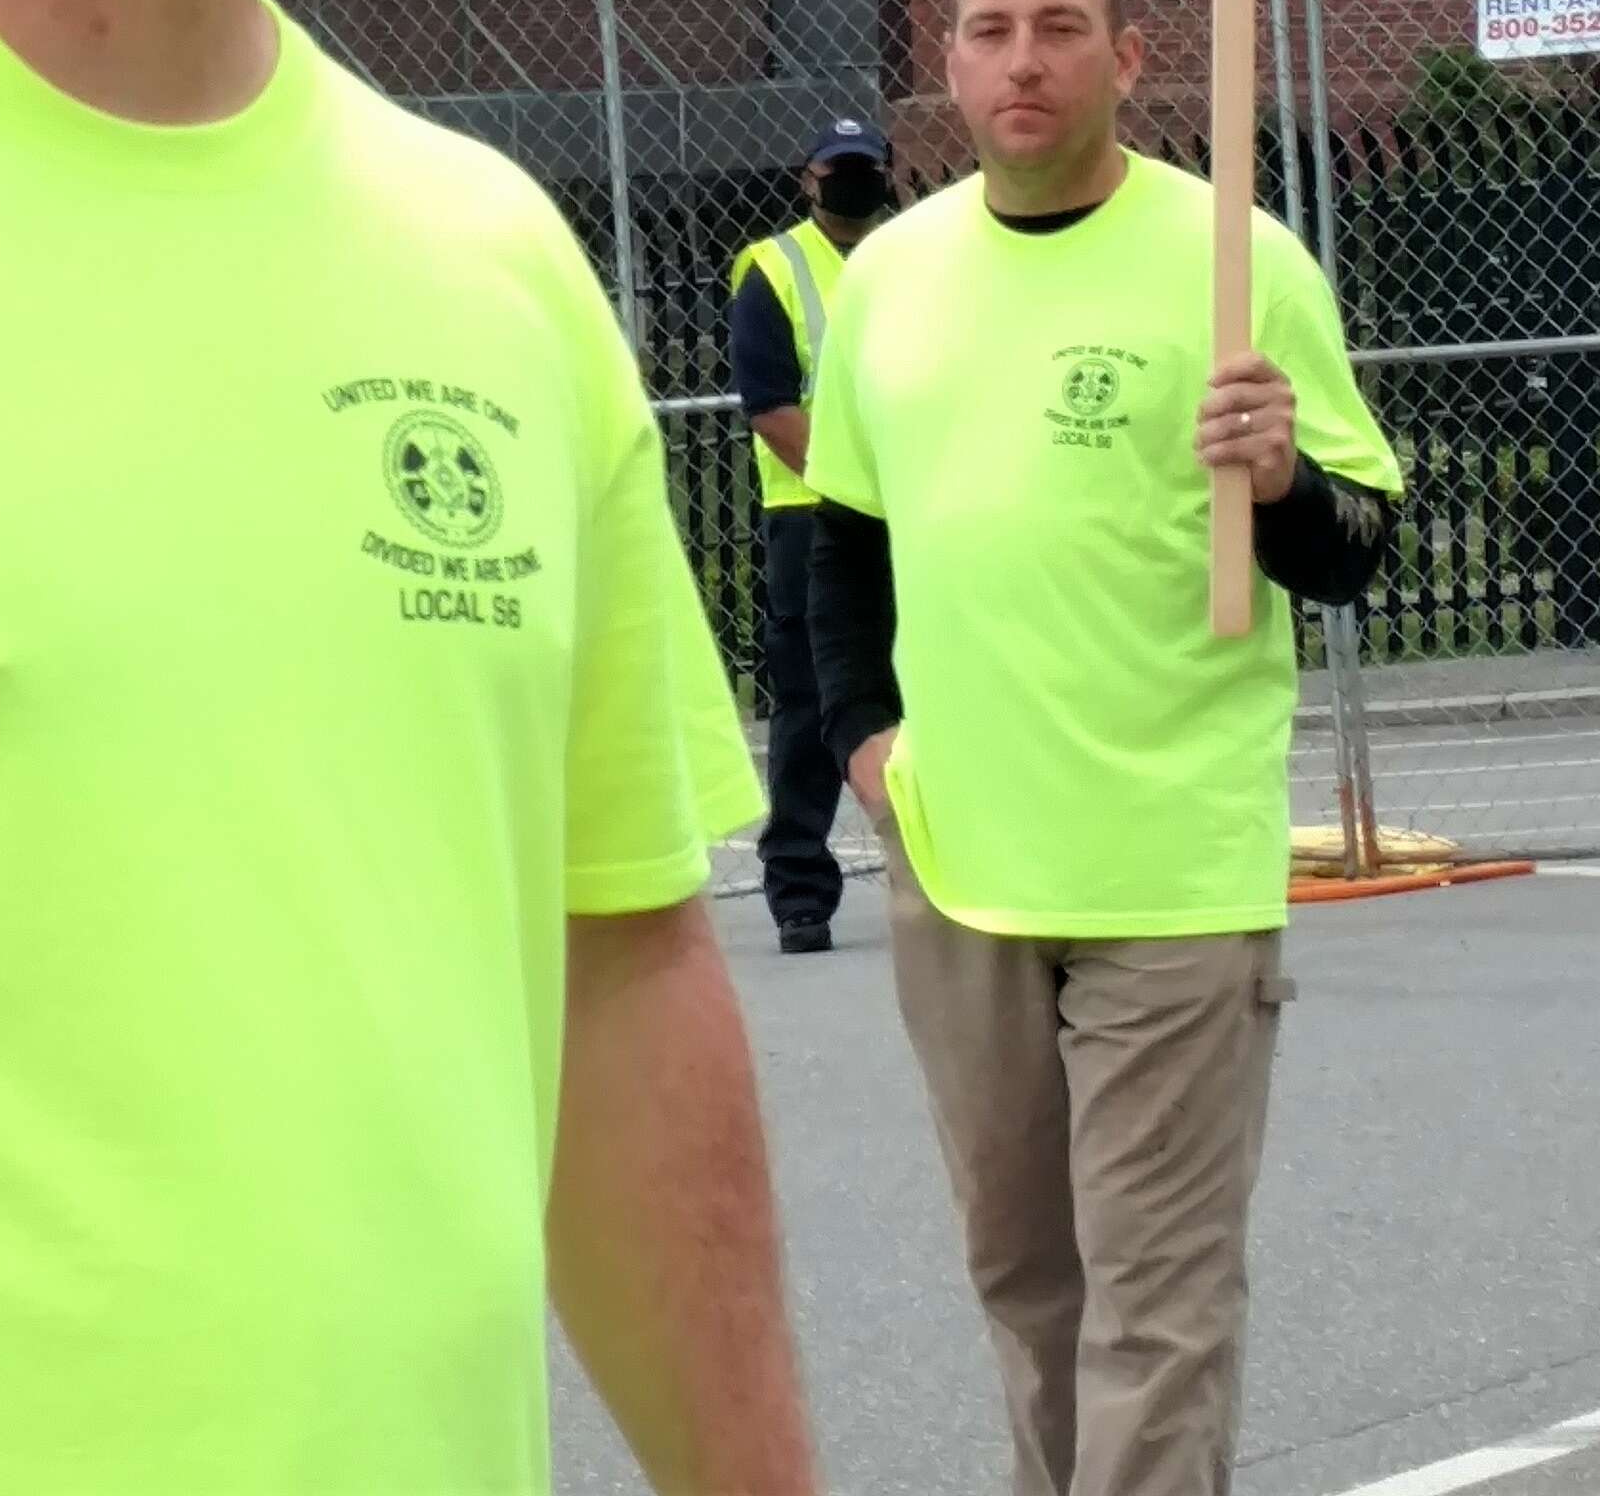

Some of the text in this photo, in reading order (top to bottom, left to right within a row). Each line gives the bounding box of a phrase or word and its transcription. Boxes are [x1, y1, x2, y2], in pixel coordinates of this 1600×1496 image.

[320, 378, 398, 413] UNITED
[400, 377, 437, 403] WE
[441, 383, 481, 415] ARE
[360, 528, 437, 577] DIVIDED
[440, 554, 471, 583] WE
[399, 586, 522, 630] LOCAL S6
